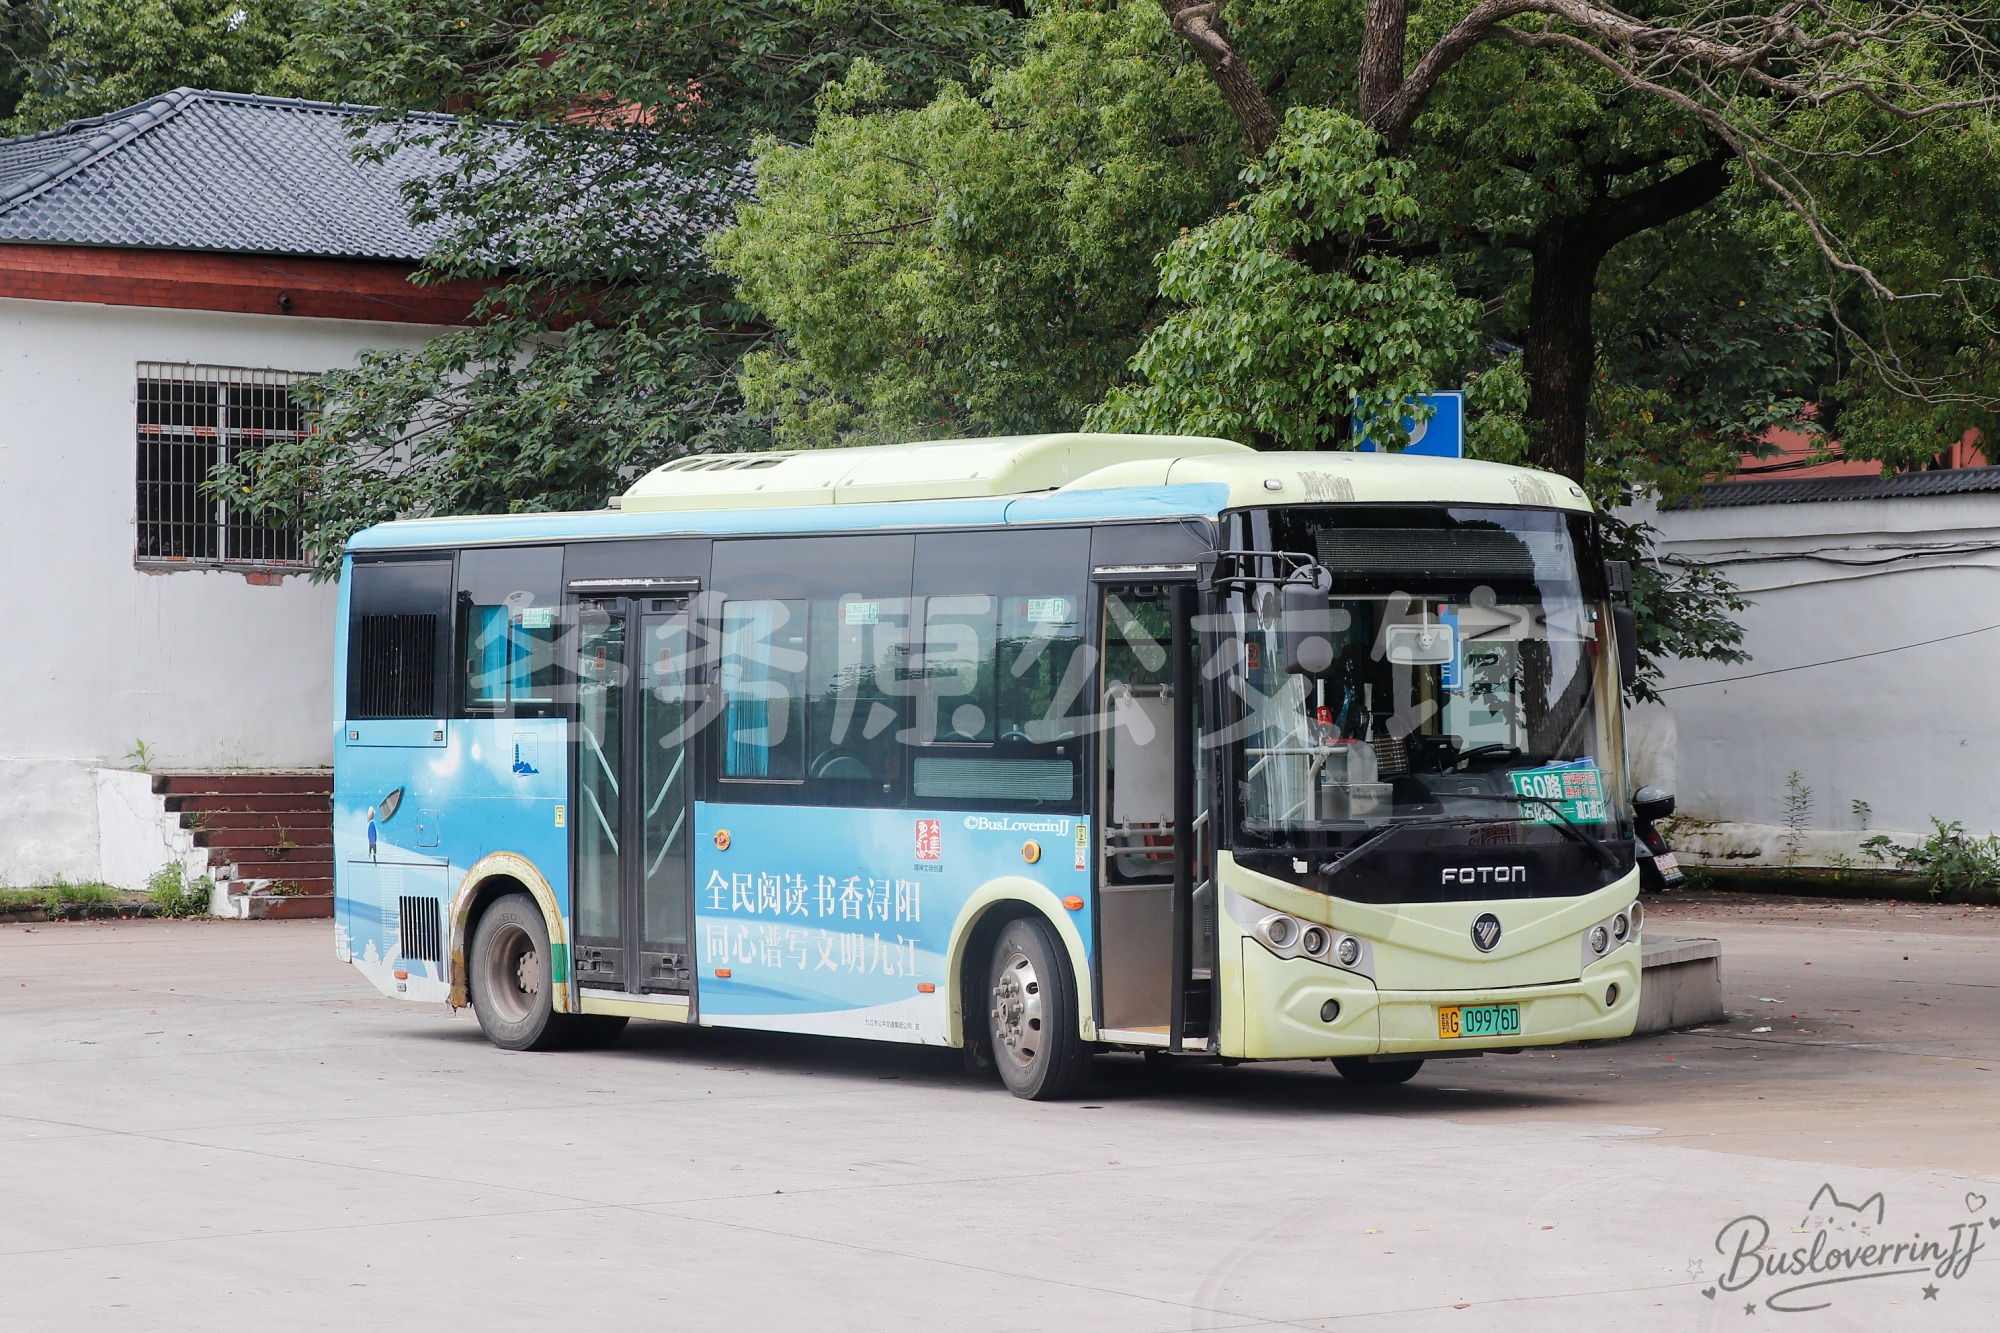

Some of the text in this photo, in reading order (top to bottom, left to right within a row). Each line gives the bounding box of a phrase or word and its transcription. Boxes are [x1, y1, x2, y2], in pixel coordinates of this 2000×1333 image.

[1520, 773, 1563, 799] 60路
[1442, 866, 1526, 885] FOTON
[705, 869, 921, 922] 全民阅读书香浔阳
[706, 923, 922, 978] 同心谱写文明九江
[1465, 1008, 1518, 1033] 09976D
